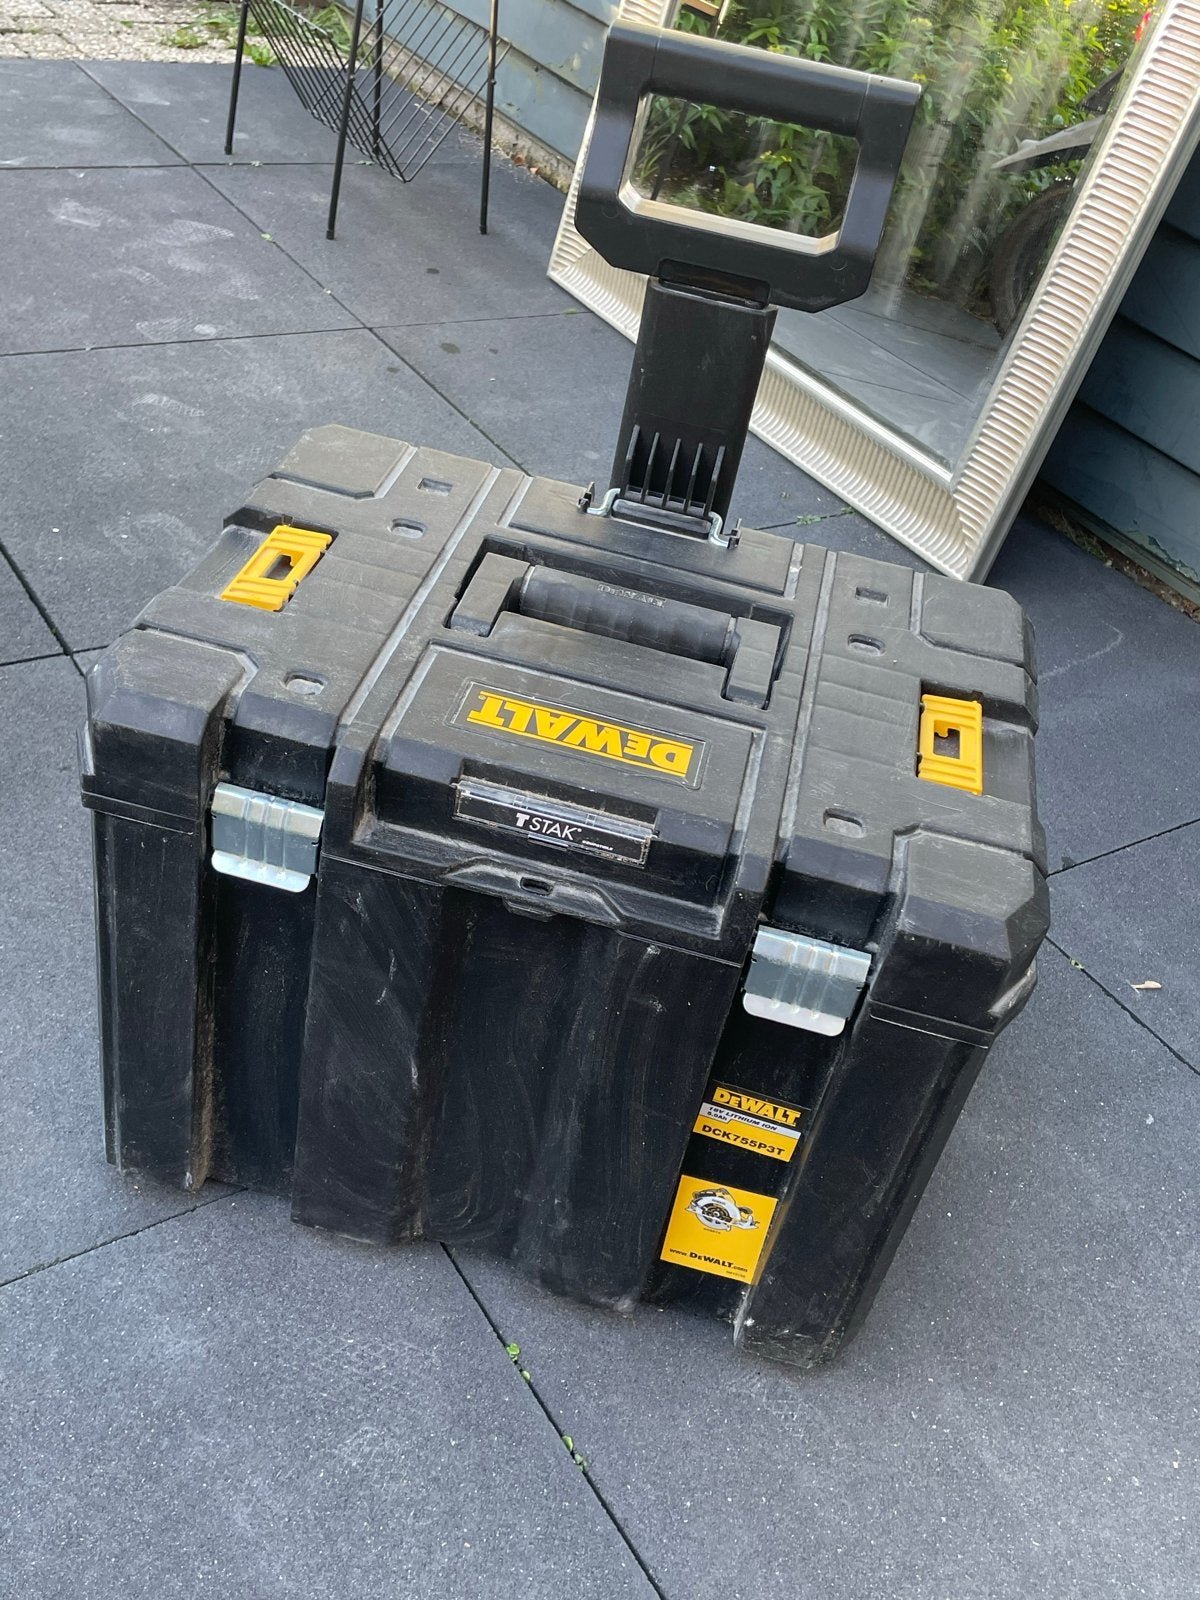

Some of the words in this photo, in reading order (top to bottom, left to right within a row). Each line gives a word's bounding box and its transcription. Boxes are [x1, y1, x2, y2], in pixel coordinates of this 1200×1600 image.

[467, 694, 694, 774] DEWALT
[706, 1111, 728, 1121] 5.0Ah
[708, 1106, 725, 1114] 18V
[725, 1111, 761, 1127] LITHIUM
[761, 1123, 778, 1131] ION
[712, 1087, 801, 1126] DEWALT
[702, 1124, 785, 1156] DCK755P3T
